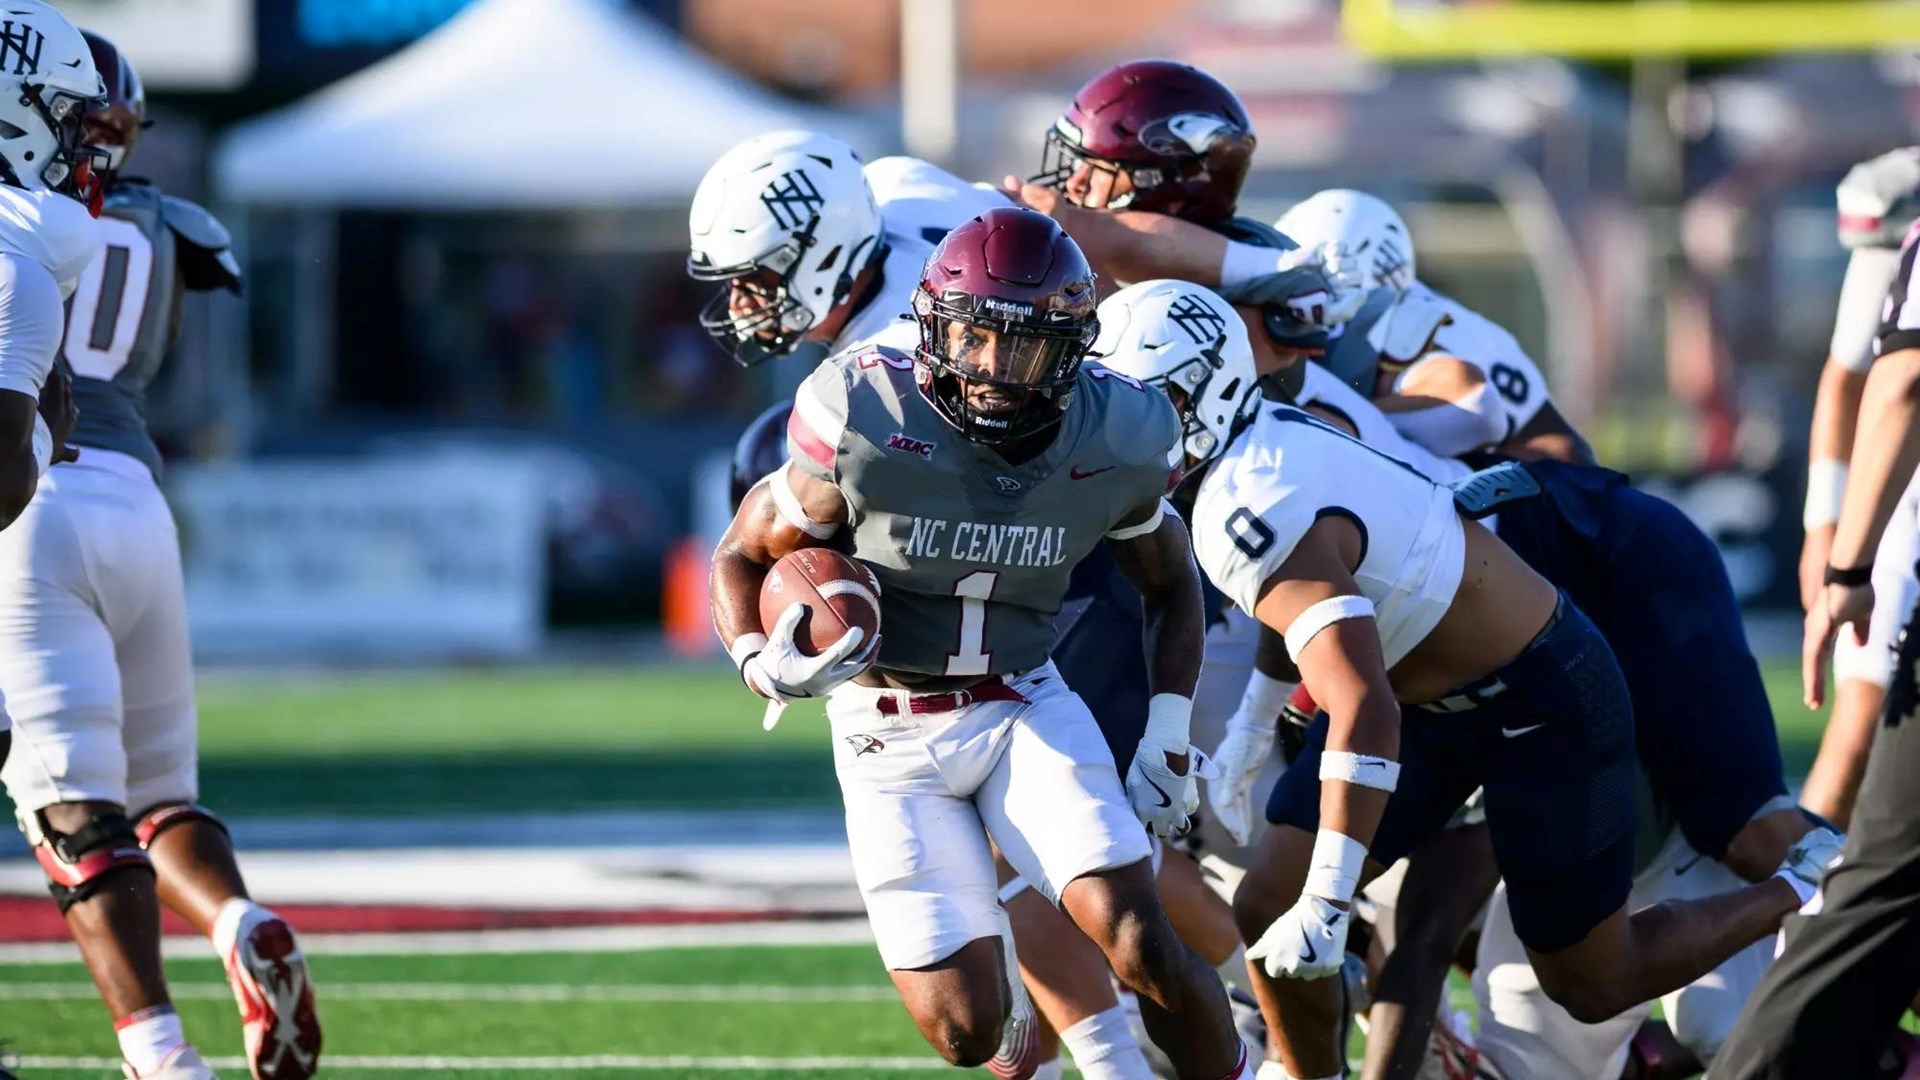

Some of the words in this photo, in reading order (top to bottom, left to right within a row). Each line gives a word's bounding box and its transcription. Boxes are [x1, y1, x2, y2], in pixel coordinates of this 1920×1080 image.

[985, 298, 1034, 316] Riddell
[974, 416, 1008, 429] Riddell
[905, 516, 947, 558] NC
[950, 521, 1067, 567] CENTRAL
[1225, 506, 1278, 560] 0
[943, 569, 999, 676] 1
